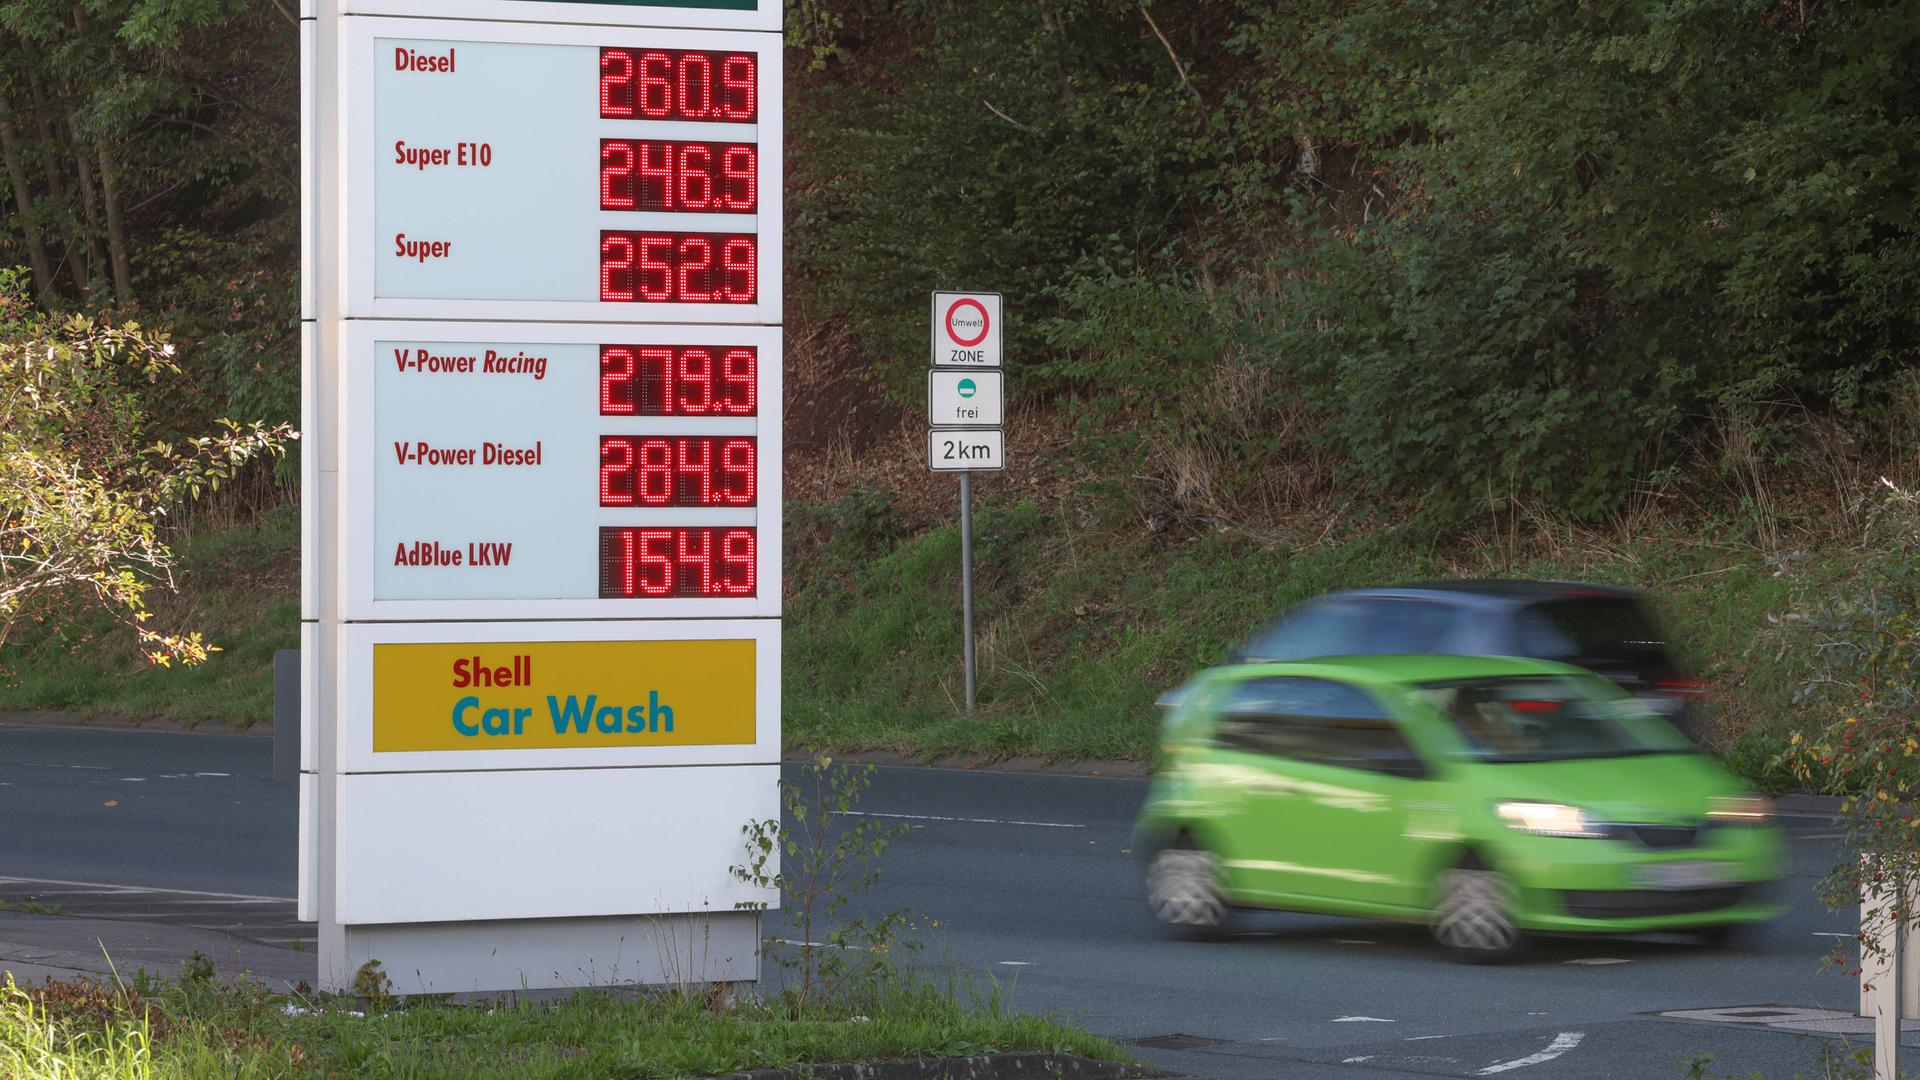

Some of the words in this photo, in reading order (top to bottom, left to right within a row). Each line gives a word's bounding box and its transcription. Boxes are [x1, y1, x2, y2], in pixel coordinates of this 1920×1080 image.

[395, 48, 455, 73] Diesel
[601, 51, 755, 119] 260.9
[395, 141, 450, 170] Super
[457, 143, 491, 167] E10
[602, 143, 755, 209] 246.9
[395, 234, 451, 262] Super
[602, 236, 755, 300] 252.9
[952, 318, 983, 327] Umwelt
[395, 349, 476, 373] V-Power
[483, 351, 547, 380] Racing
[951, 350, 984, 362] ZONE
[602, 349, 755, 412] 279.9
[957, 407, 978, 418] frei
[395, 442, 475, 465] V-Power
[483, 441, 541, 466] Diesel
[602, 440, 755, 503] 284.9
[395, 543, 462, 567] AdBlue
[469, 543, 512, 566] LKW
[622, 531, 755, 594] 154.9
[452, 656, 531, 688] Shell
[452, 696, 532, 737] Car
[546, 690, 674, 734] Wash
